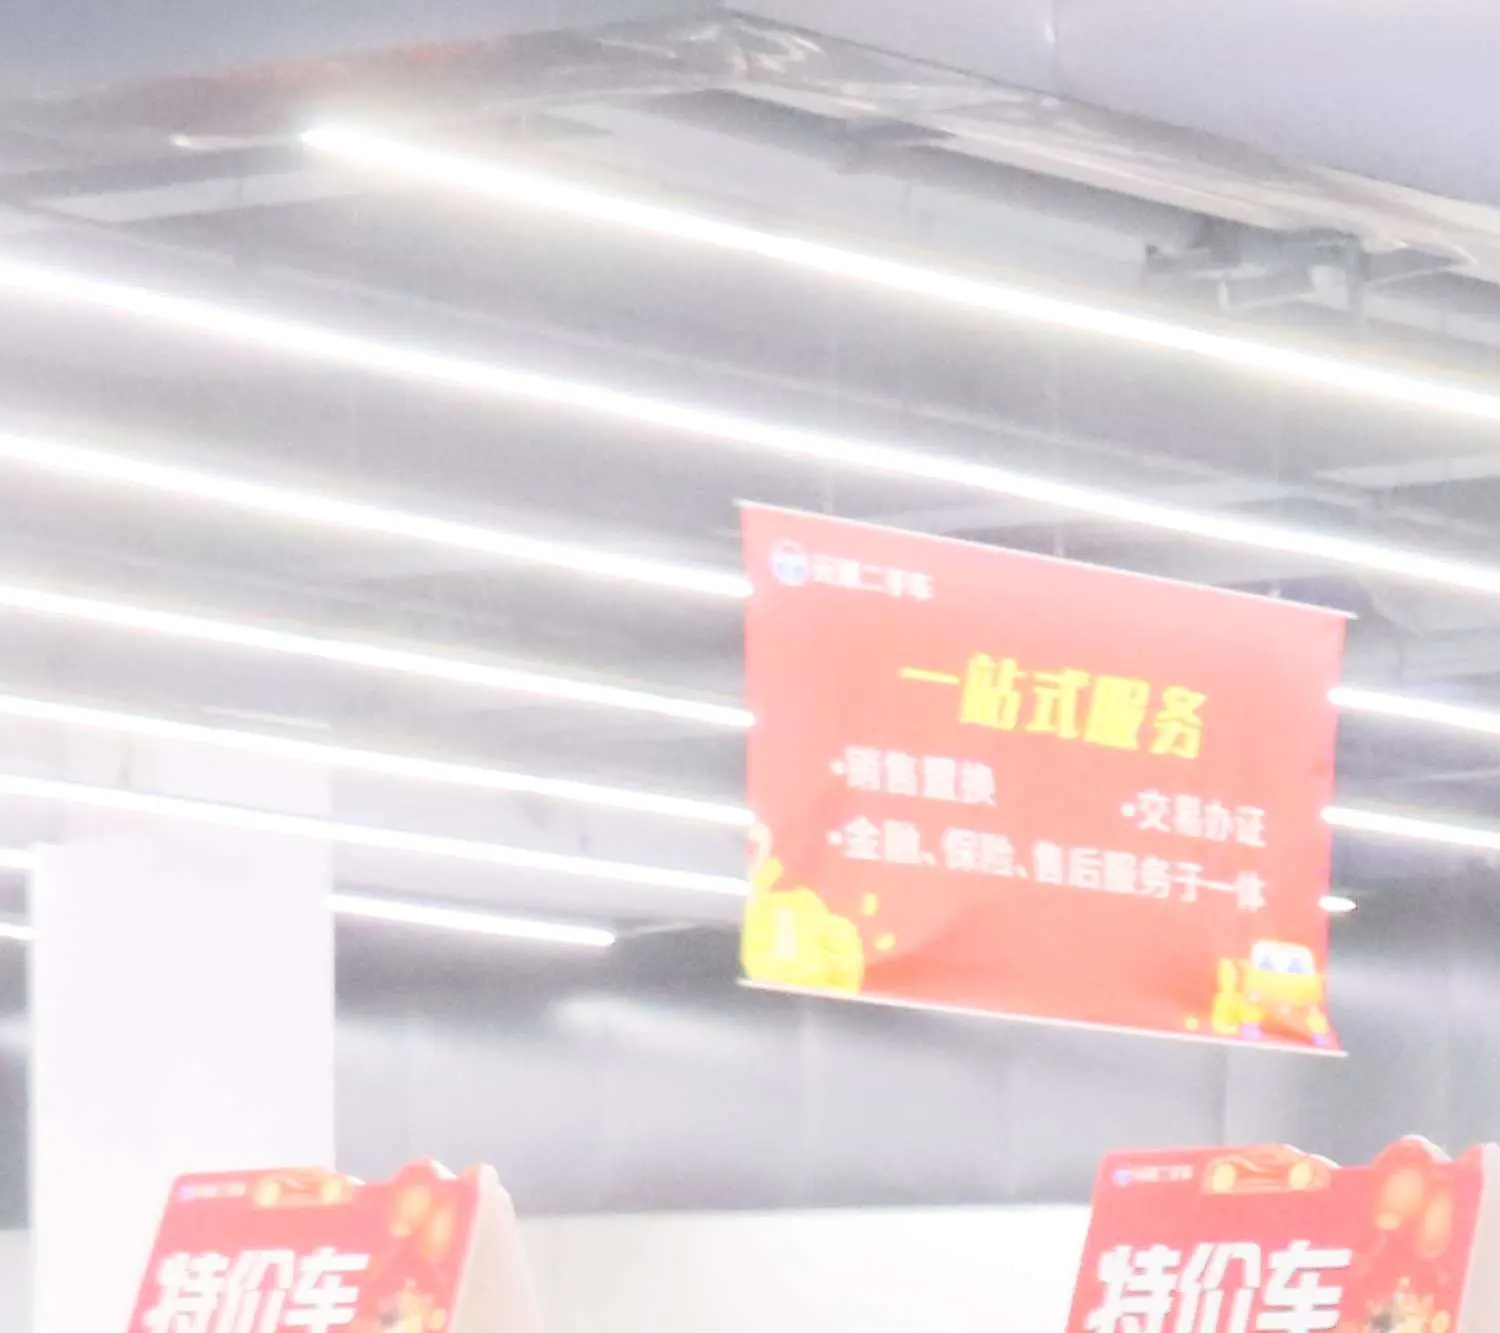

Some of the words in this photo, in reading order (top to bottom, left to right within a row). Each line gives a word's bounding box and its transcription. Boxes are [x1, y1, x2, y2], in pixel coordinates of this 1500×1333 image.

[897, 652, 1207, 759] 一站式服务
